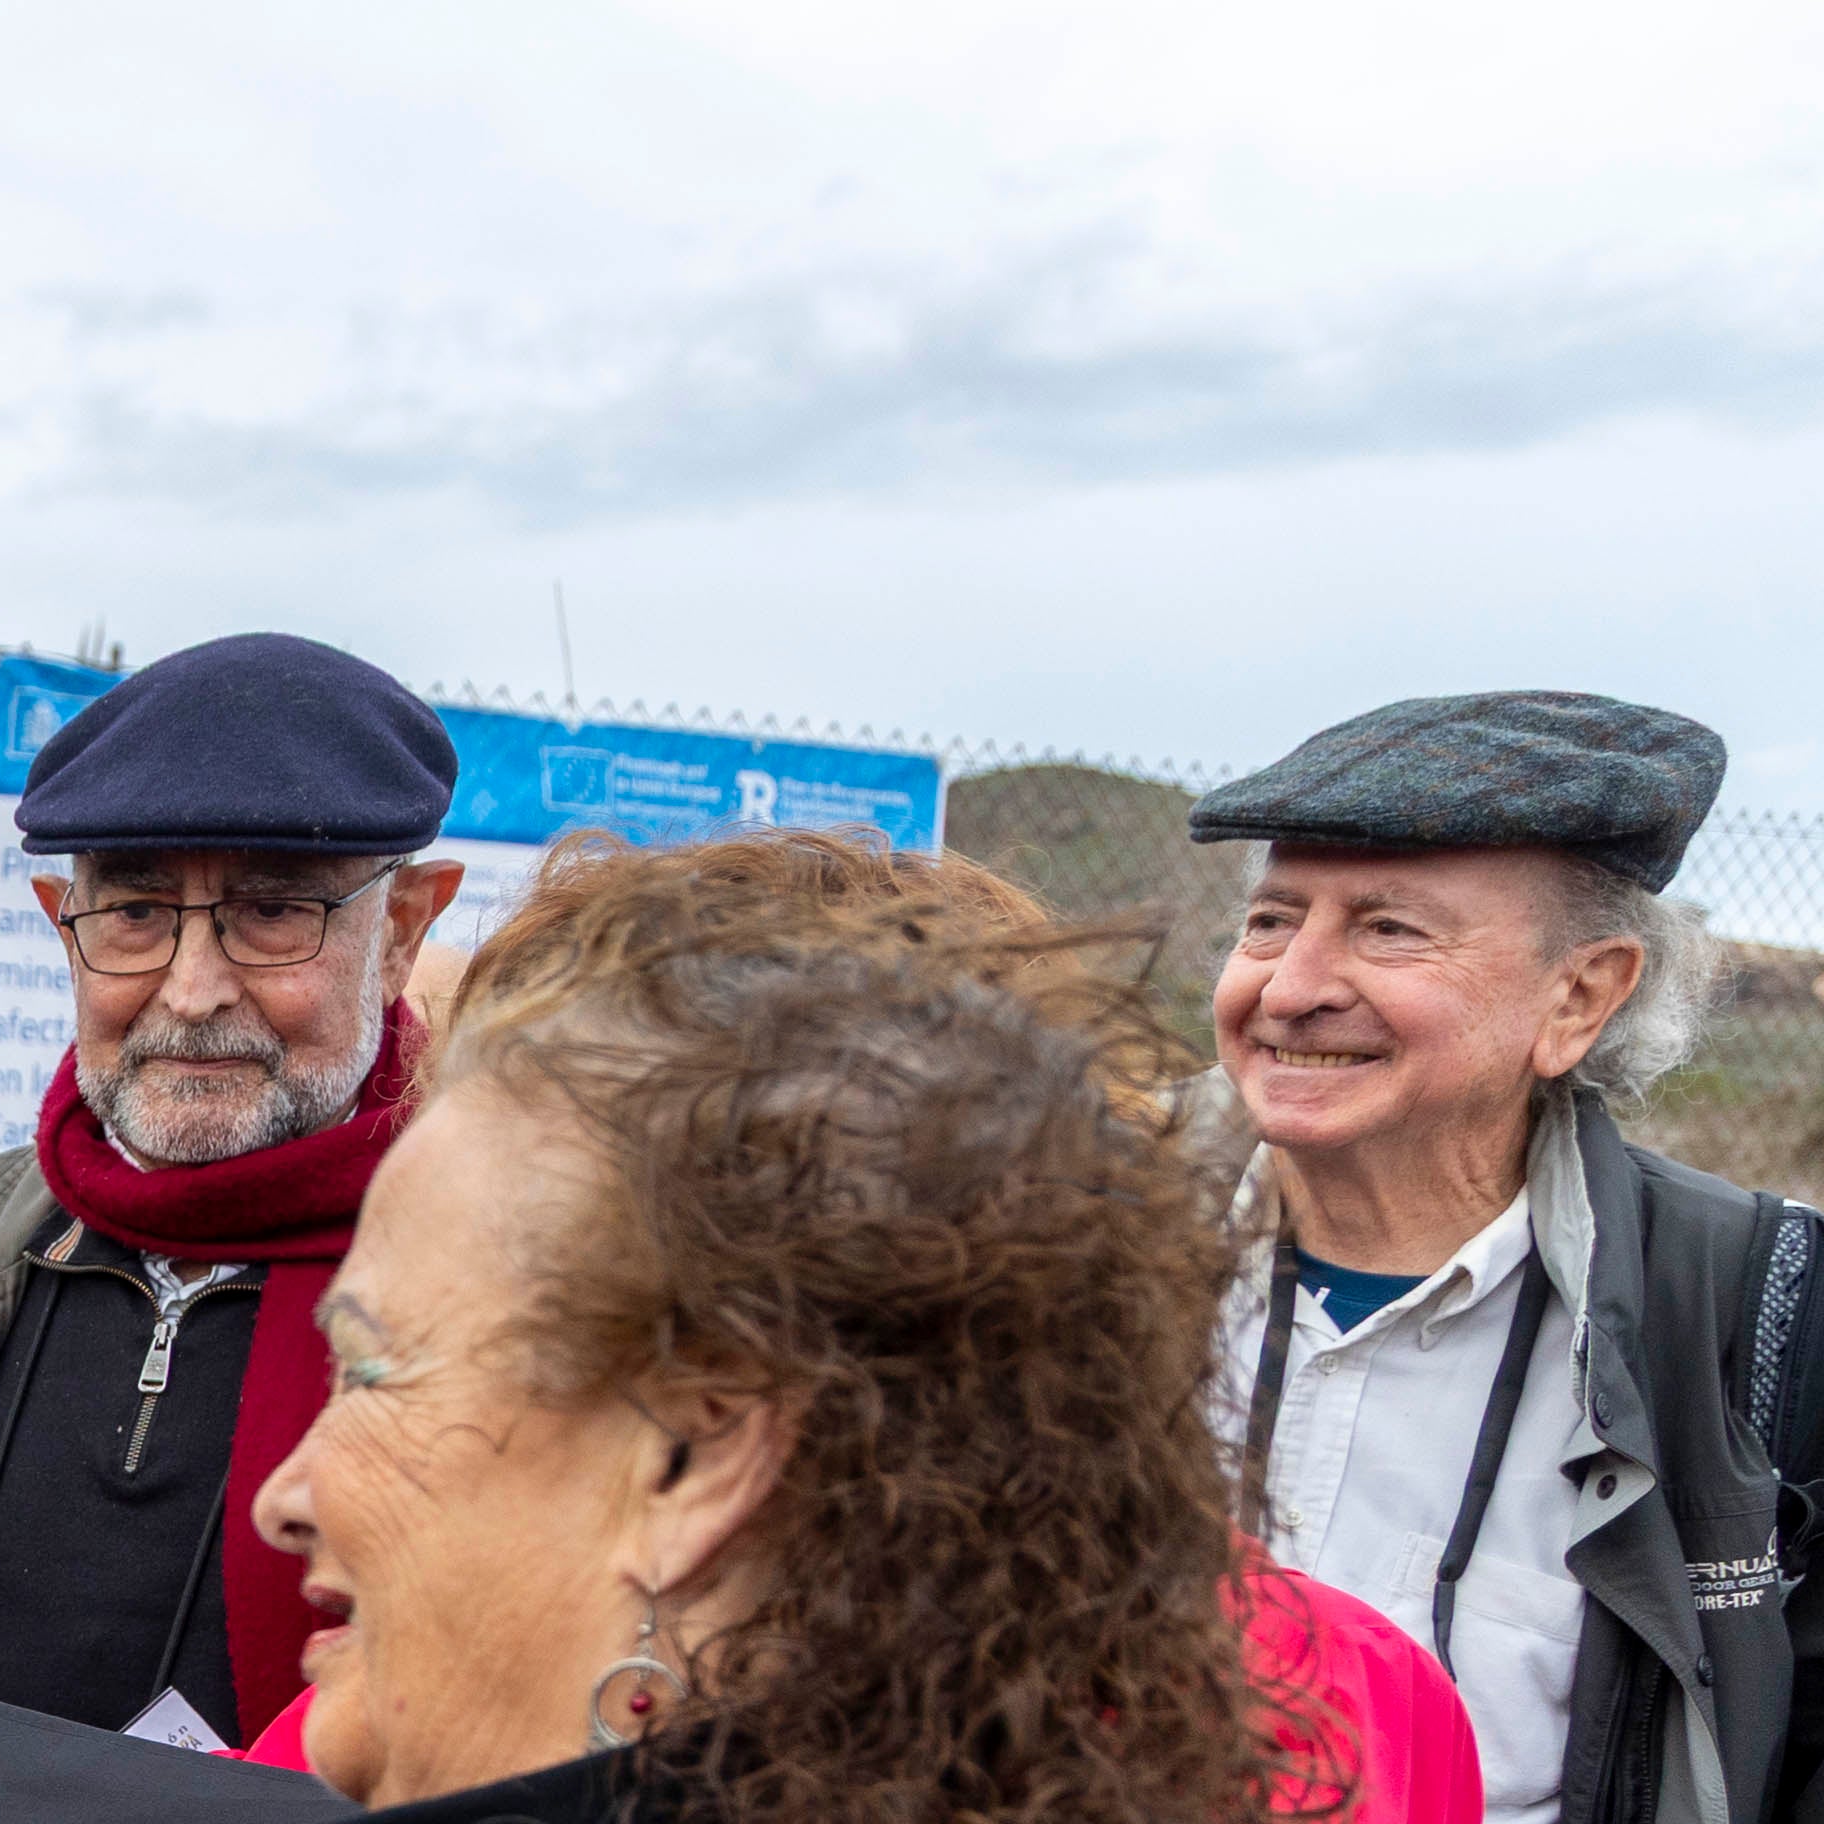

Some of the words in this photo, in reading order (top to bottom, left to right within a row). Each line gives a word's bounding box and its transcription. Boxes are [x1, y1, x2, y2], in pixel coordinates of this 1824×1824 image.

[1685, 1555, 1778, 1579] ERNUA
[1692, 1579, 1736, 1592] DOOR
[1694, 1589, 1764, 1611] ORE-TEX
